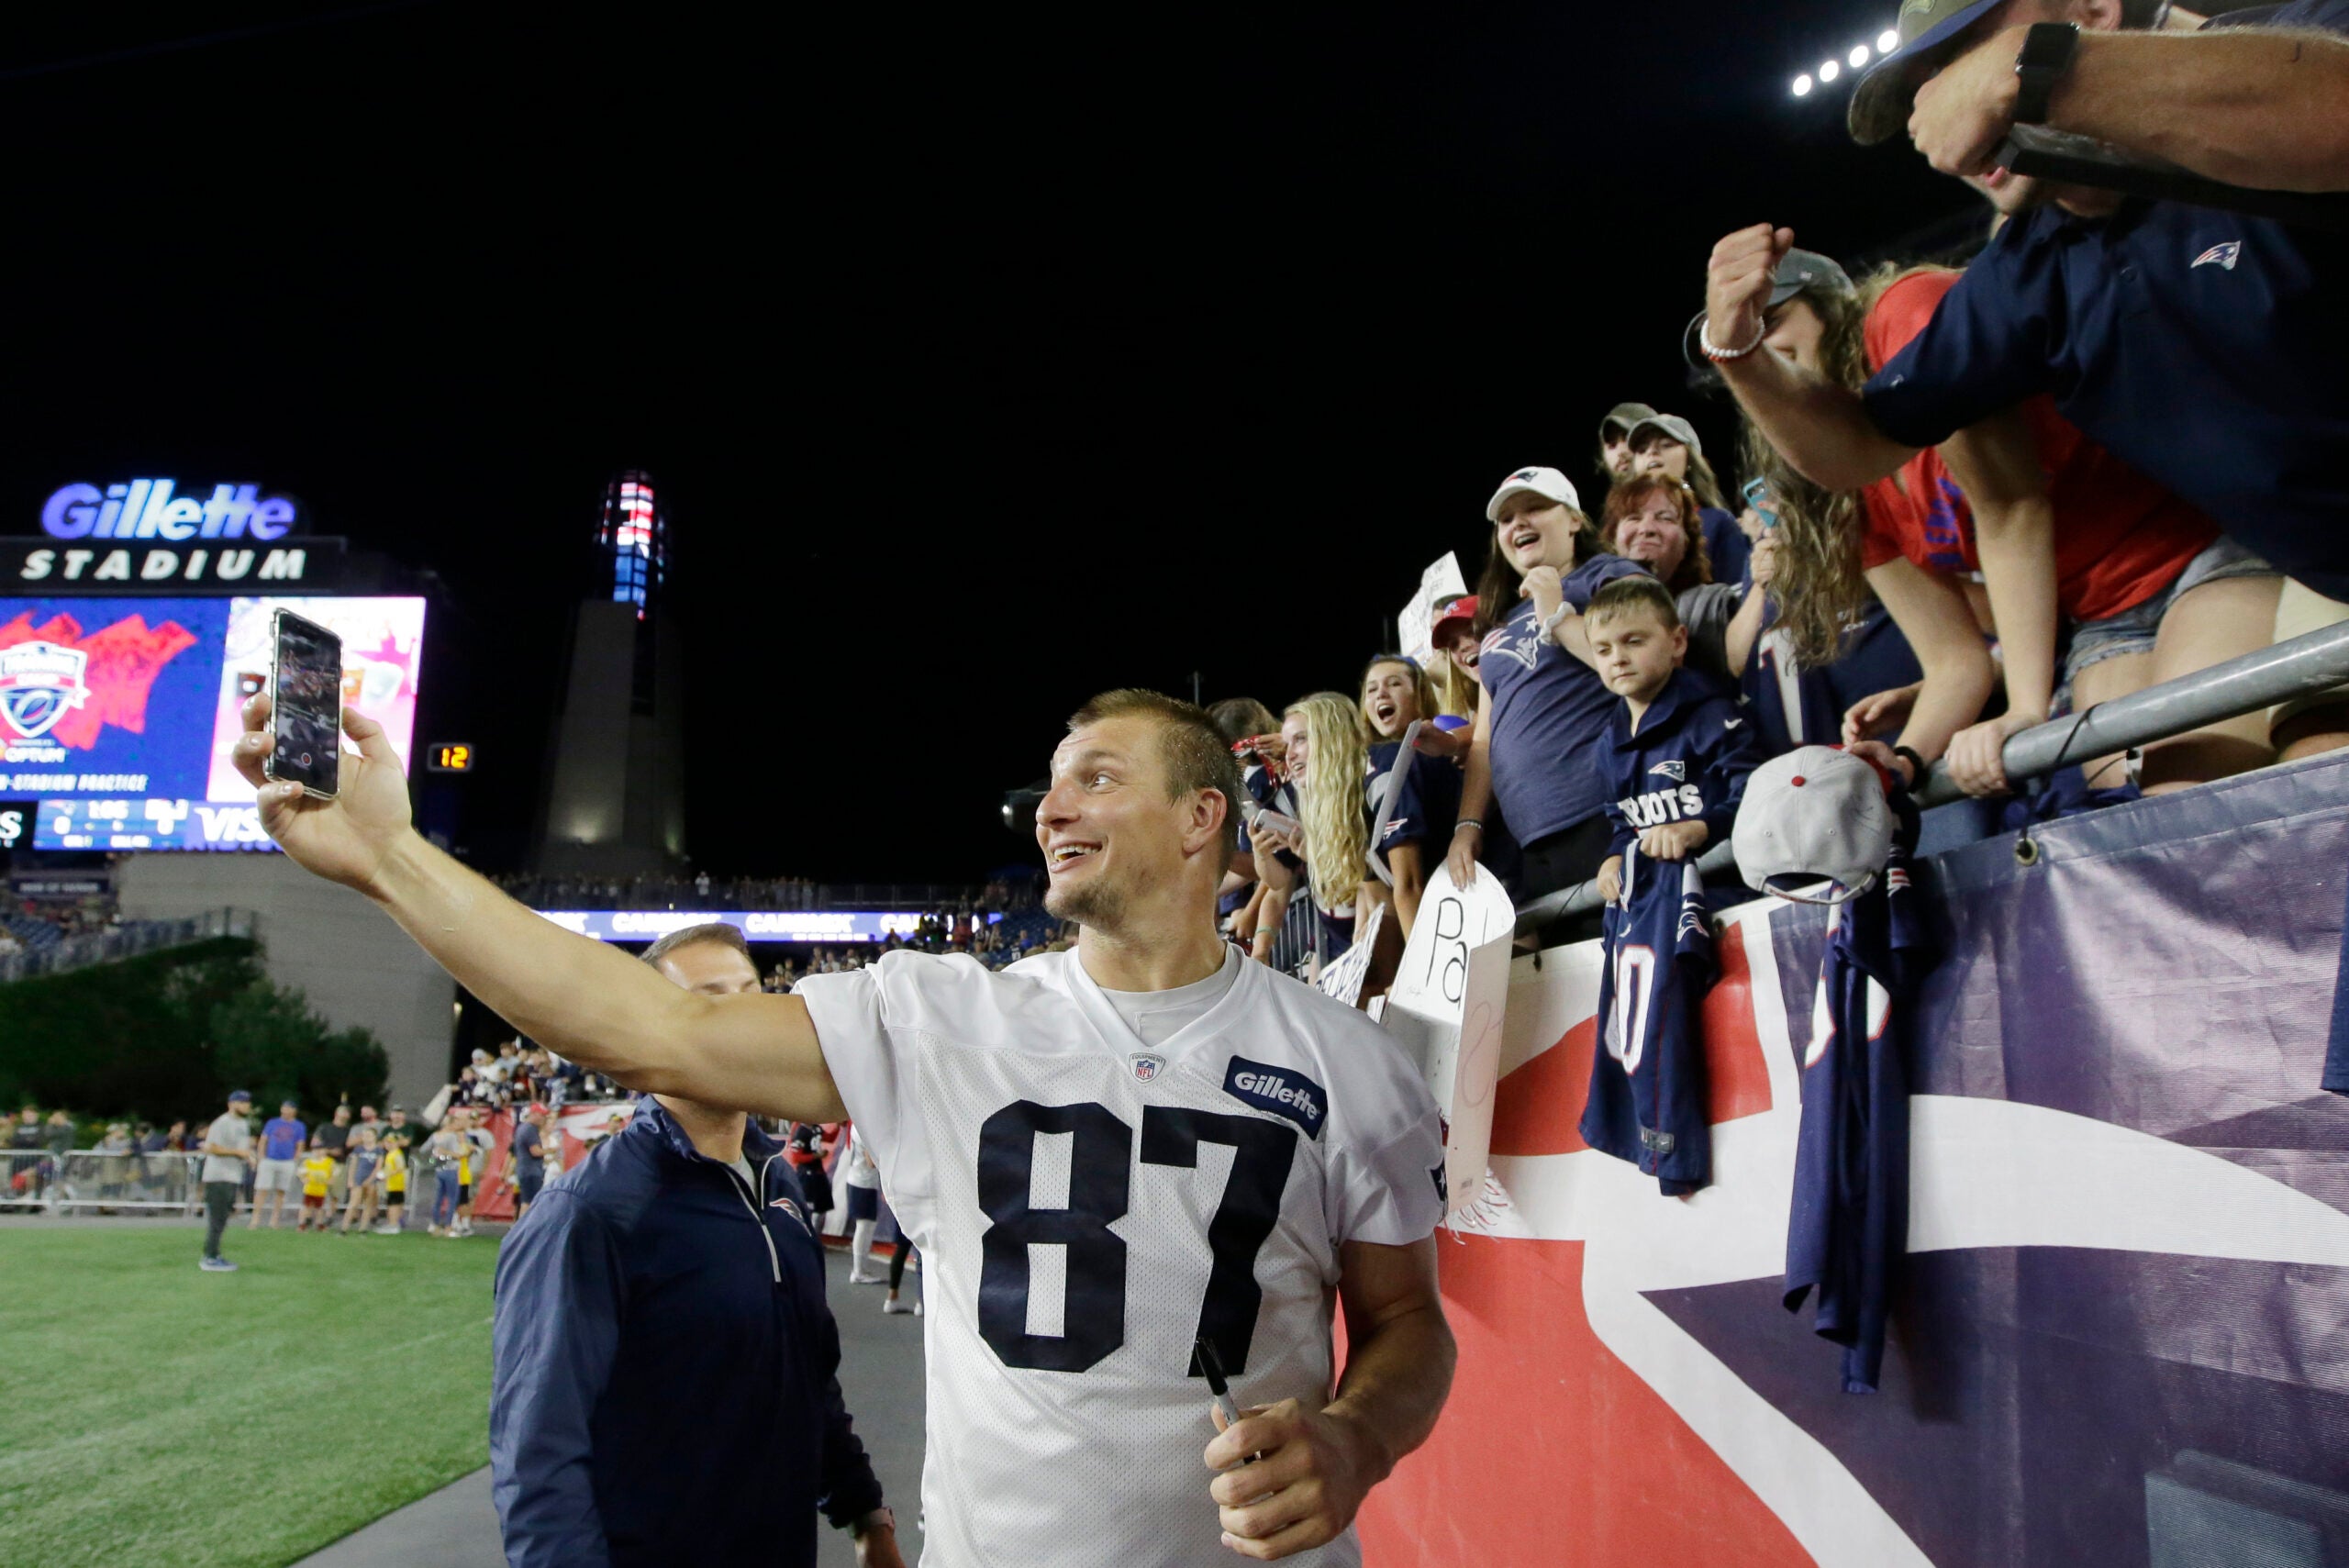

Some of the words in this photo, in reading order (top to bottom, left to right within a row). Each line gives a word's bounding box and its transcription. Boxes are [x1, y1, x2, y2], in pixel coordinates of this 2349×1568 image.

[41, 478, 296, 540] Gillette
[20, 549, 307, 581] STADIUM
[440, 746, 470, 768] 12
[1137, 1067, 1152, 1078] NFL
[1234, 1071, 1319, 1120] Gillette
[978, 1098, 1298, 1378] 87
